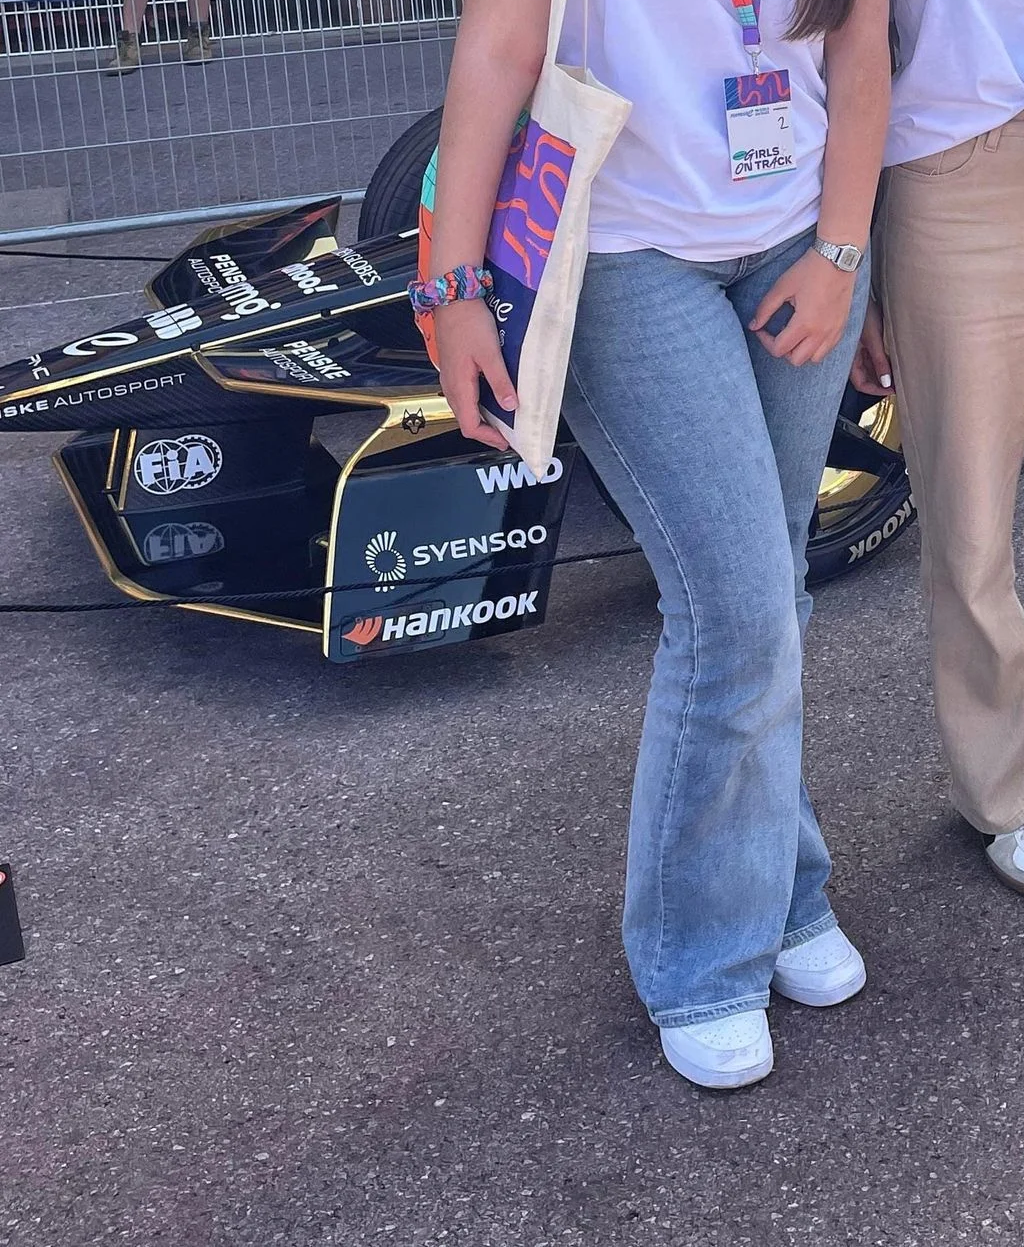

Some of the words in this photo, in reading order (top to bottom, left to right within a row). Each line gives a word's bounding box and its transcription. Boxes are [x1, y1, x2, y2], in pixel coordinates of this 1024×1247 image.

[735, 161, 753, 175] ON
[754, 155, 792, 170] TRACK
[744, 146, 780, 162] GIRLS
[188, 258, 222, 294] AUTOSPO
[209, 254, 248, 287] PENS
[259, 348, 320, 383] AUTOSPORT
[283, 340, 351, 380] PENSKE
[0, 399, 49, 419] SKE
[54, 373, 186, 409] AUTOSPORT
[412, 525, 548, 566] SYENSQO
